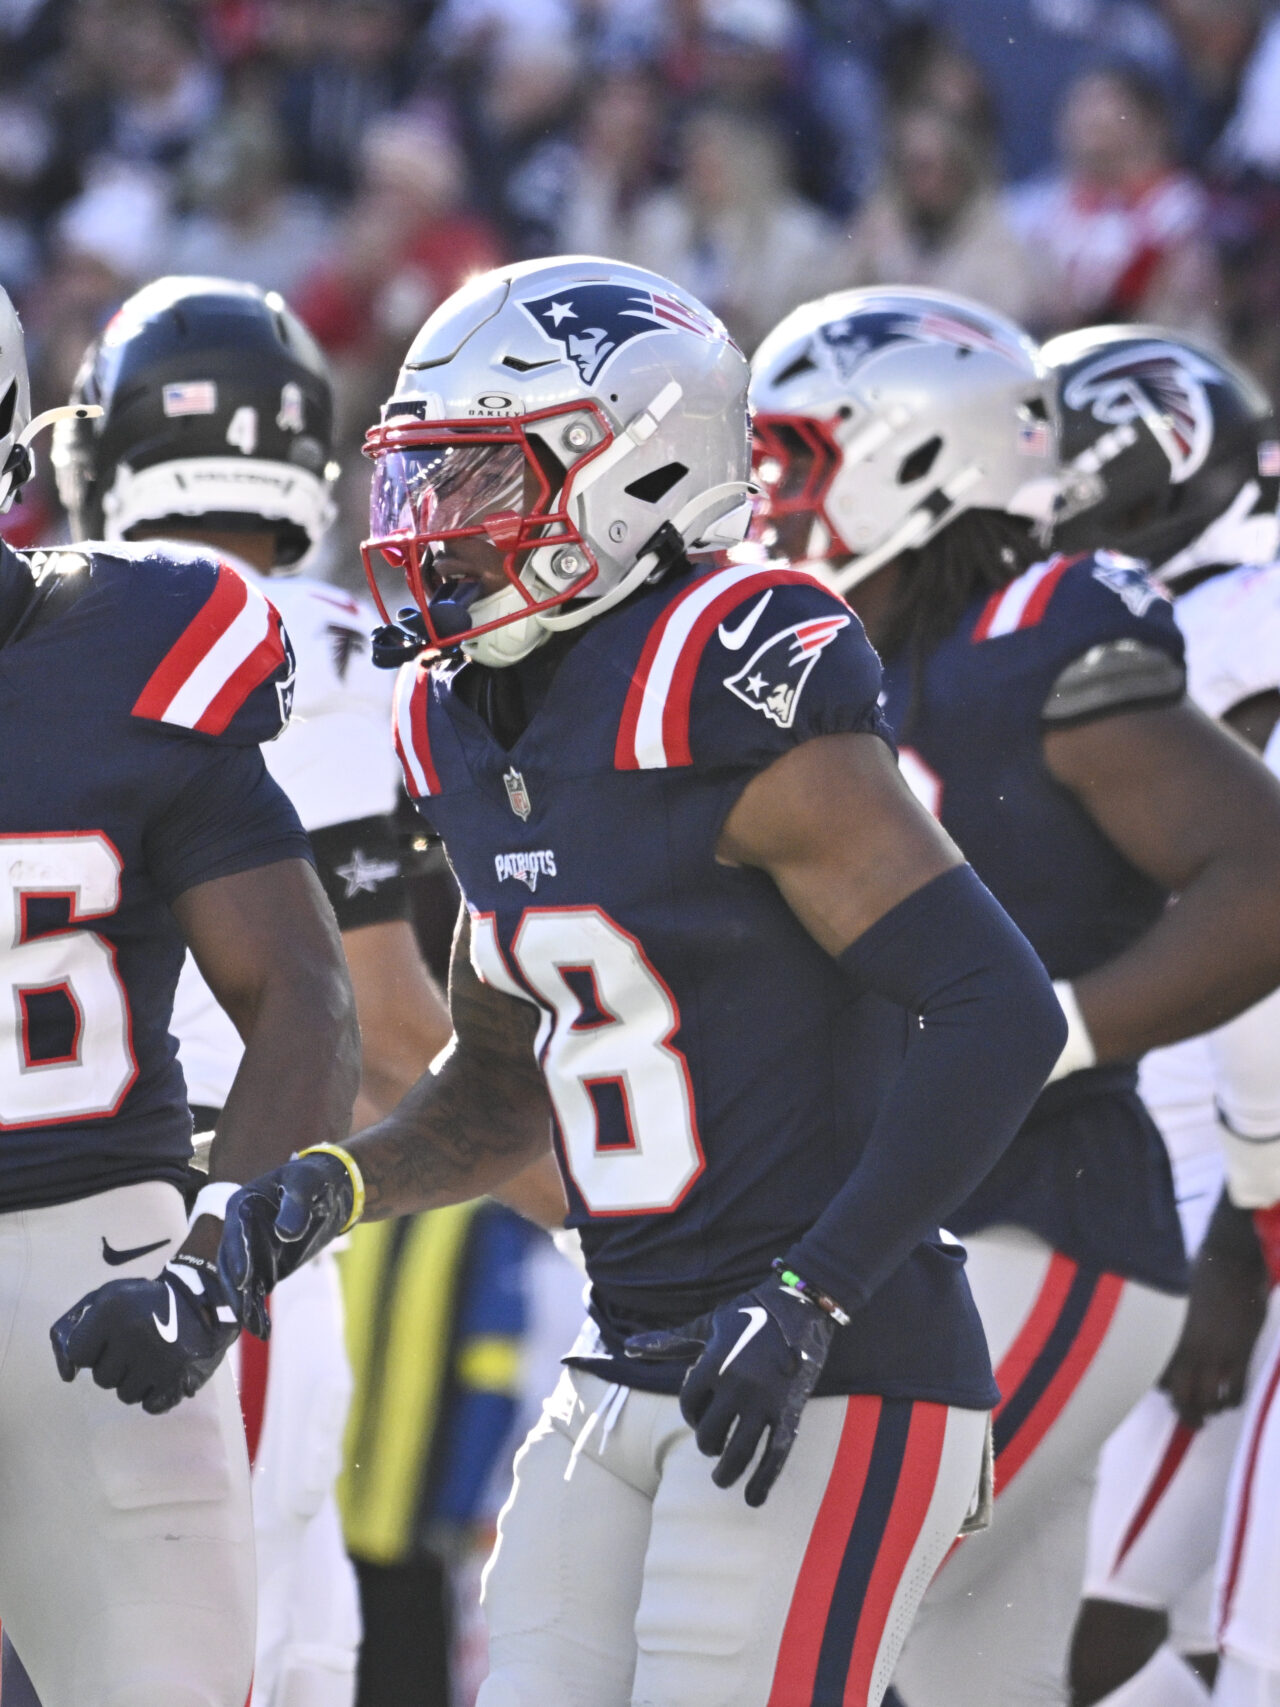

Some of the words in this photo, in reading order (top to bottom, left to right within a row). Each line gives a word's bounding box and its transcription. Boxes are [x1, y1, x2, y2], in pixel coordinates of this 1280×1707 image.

[226, 405, 259, 456] 4
[468, 409, 520, 418] OAKLEY
[494, 848, 557, 882] PATRIOTS
